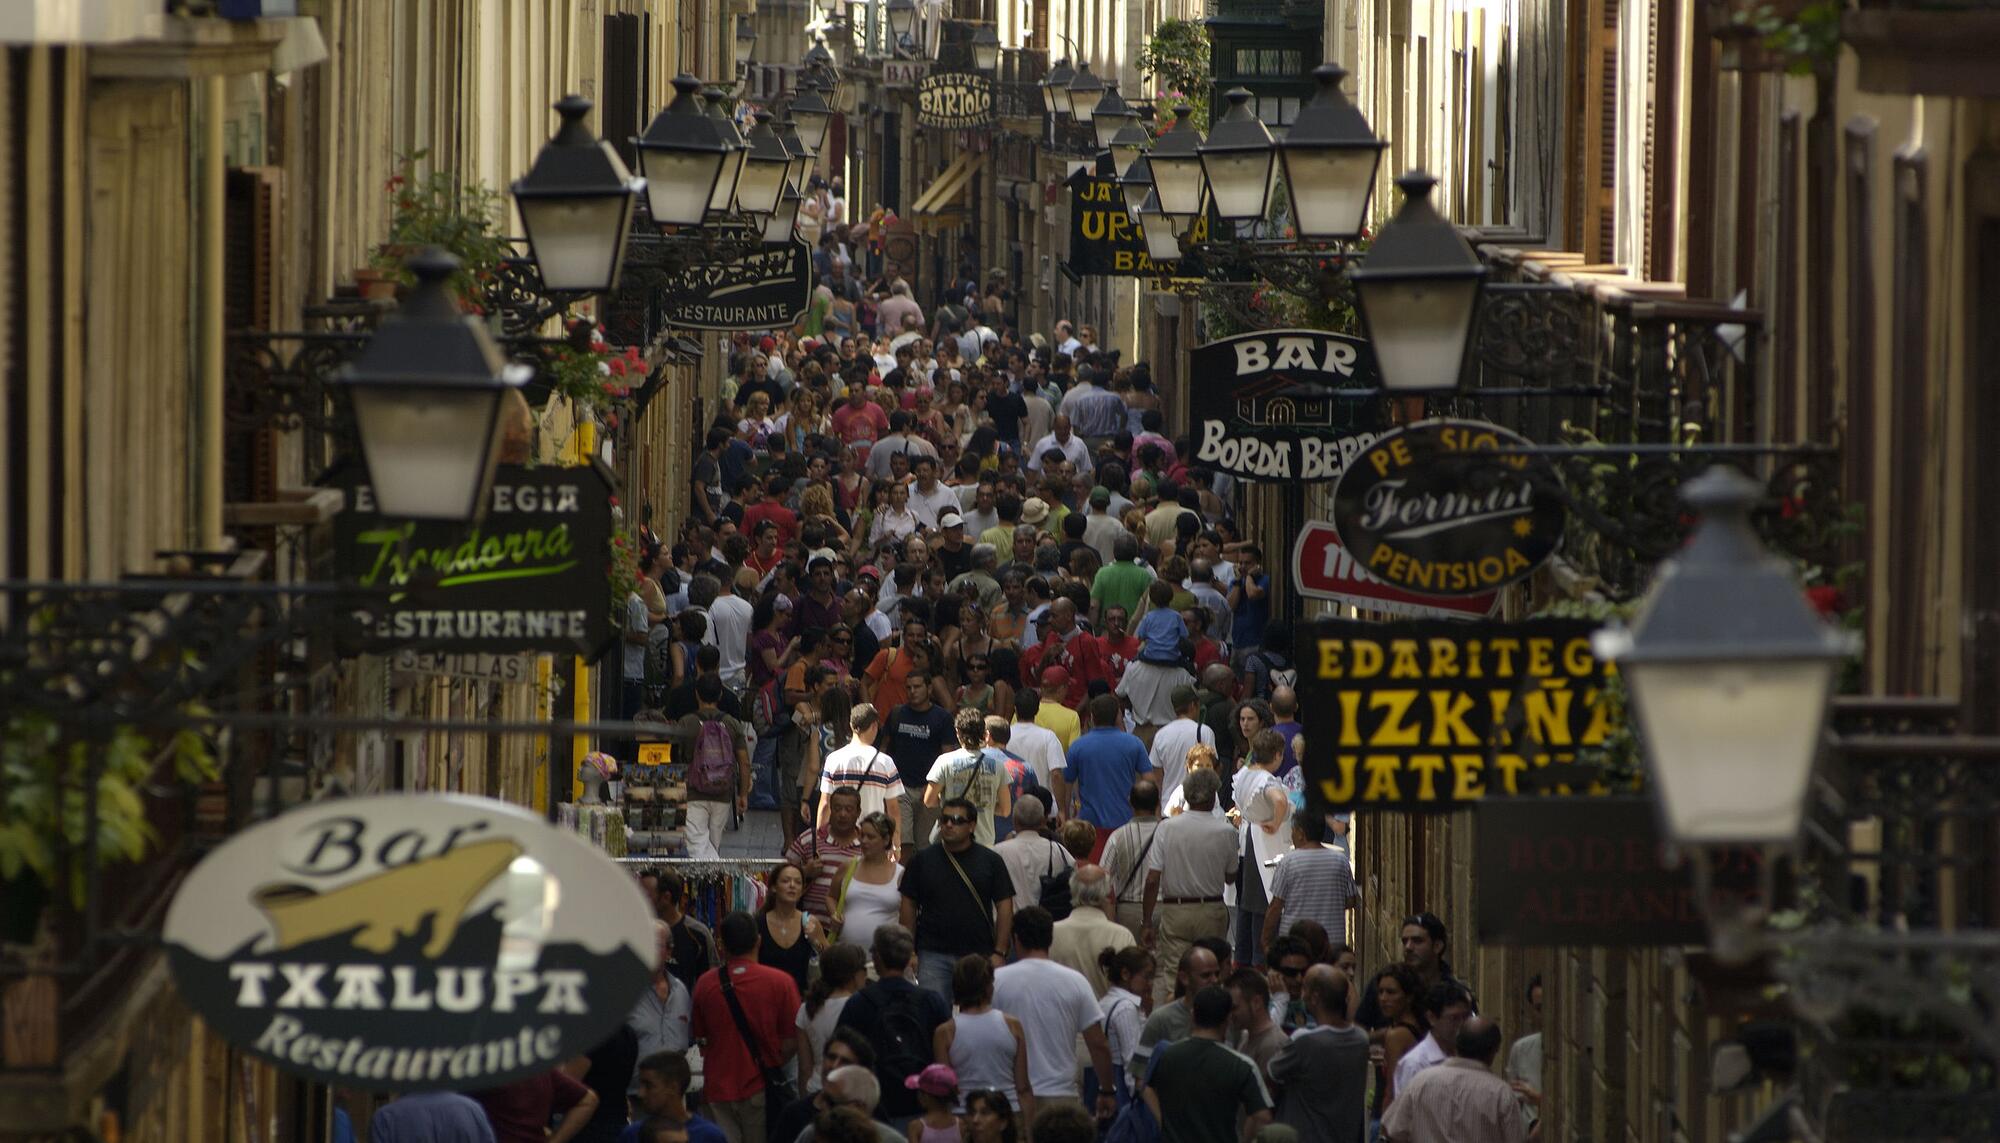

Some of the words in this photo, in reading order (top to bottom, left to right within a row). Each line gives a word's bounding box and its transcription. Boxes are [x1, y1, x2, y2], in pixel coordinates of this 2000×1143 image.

[919, 86, 991, 117] BARTOLO
[1234, 337, 1357, 377] BAR
[1197, 419, 1292, 479] BORDA
[1369, 543, 1531, 590] PENTSIOA
[281, 816, 490, 877] Bar
[228, 962, 590, 1016] TXALUPA
[253, 1014, 563, 1082] Restaurante
